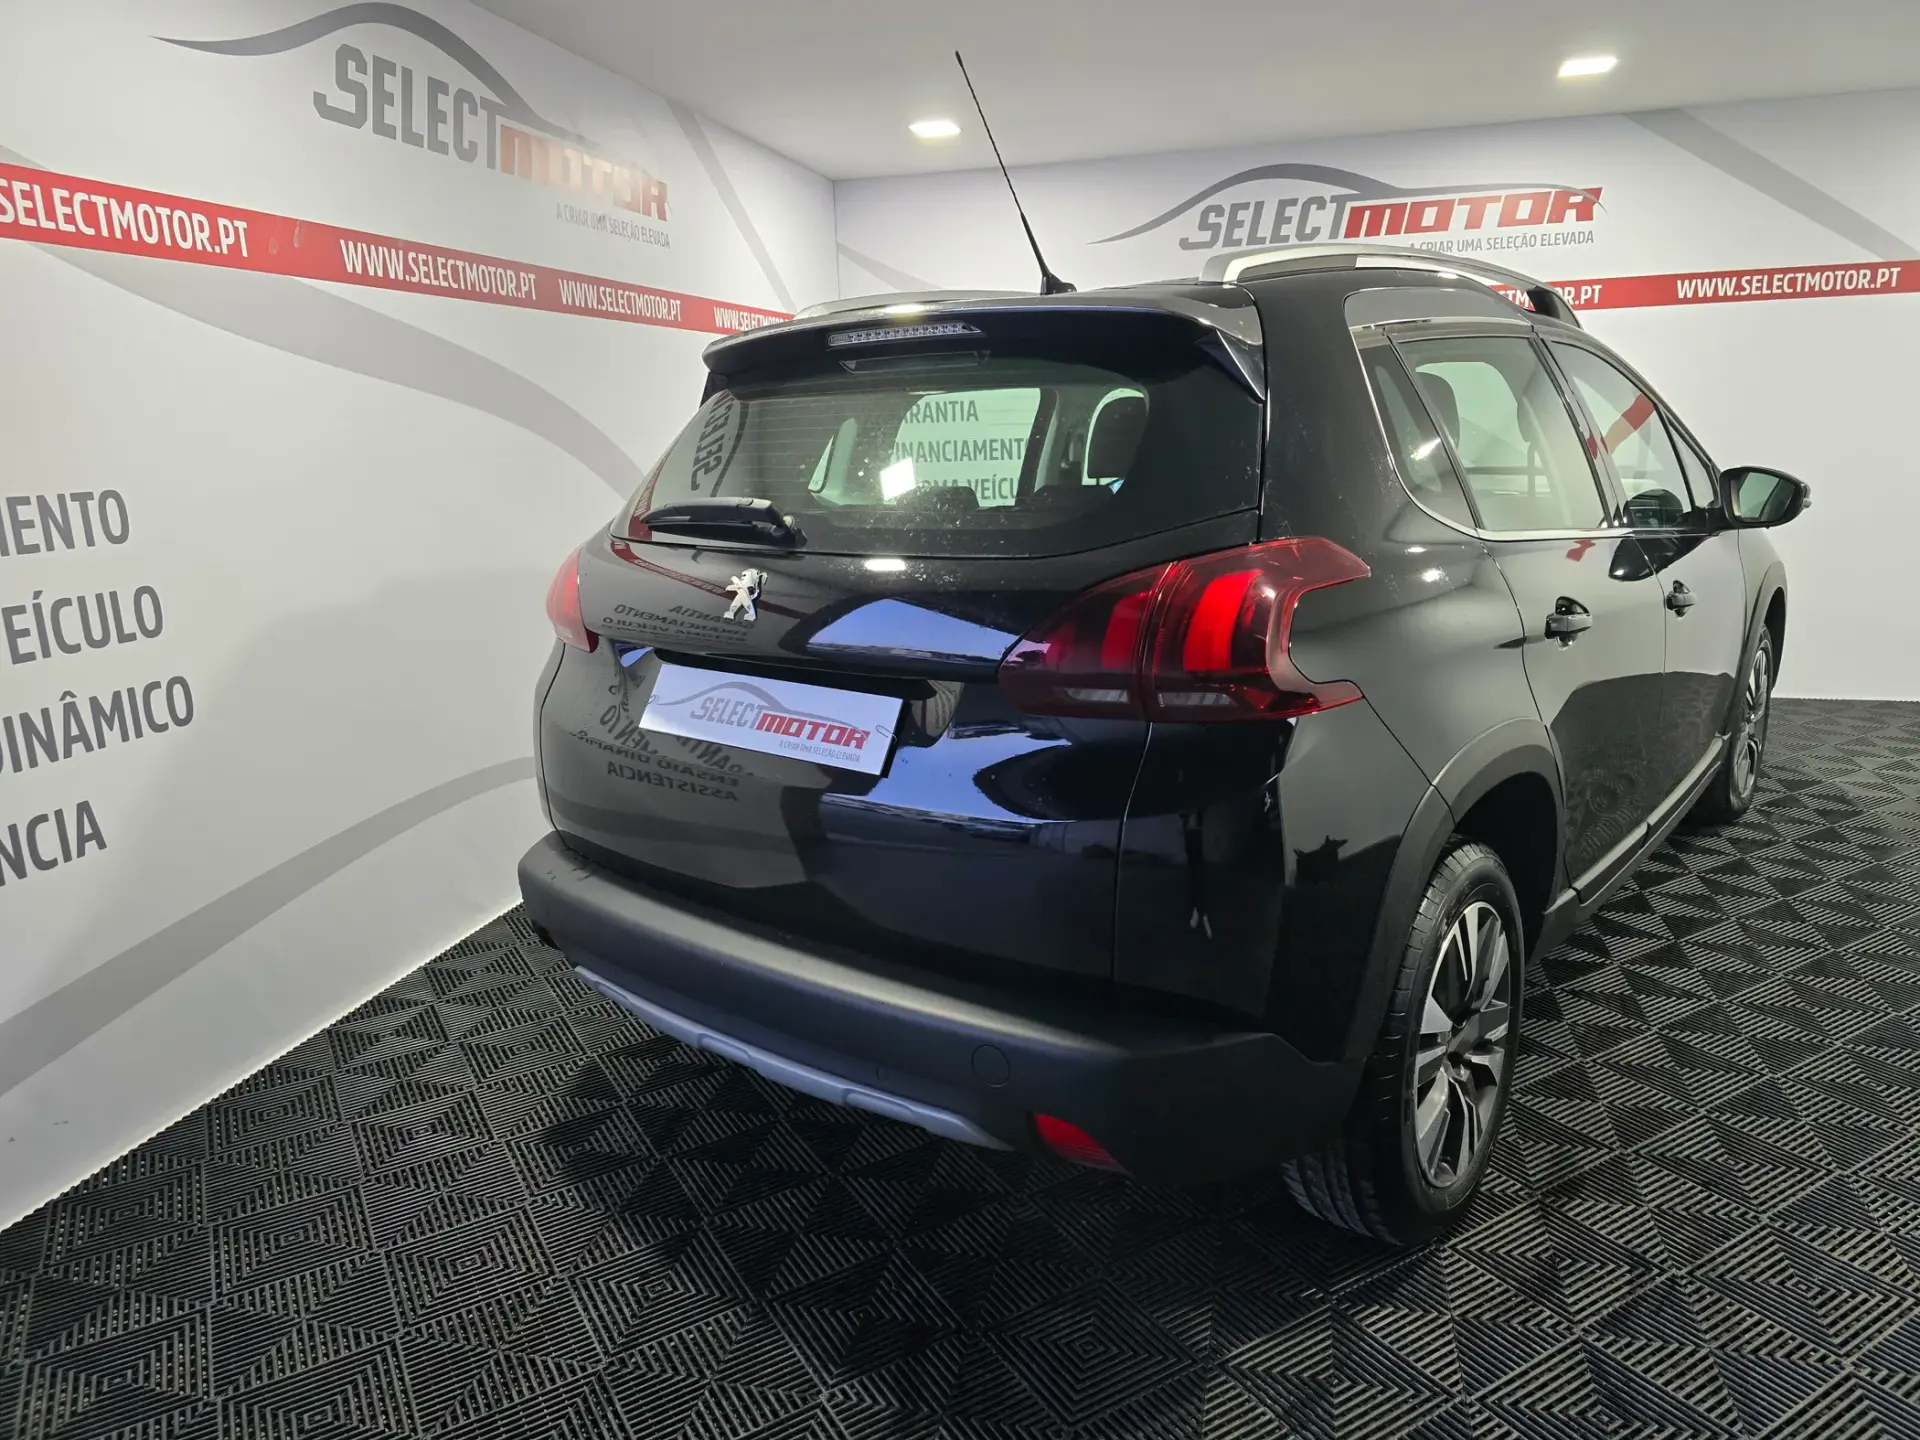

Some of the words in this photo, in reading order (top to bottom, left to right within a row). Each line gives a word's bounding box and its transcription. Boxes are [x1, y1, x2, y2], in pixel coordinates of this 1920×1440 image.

[640, 227, 671, 249] ELEVADA
[1179, 187, 1603, 251] SELECTMOTOR
[1457, 238, 1482, 252] UMA
[1486, 233, 1537, 251] SELEÇÃO
[1540, 230, 1594, 246] ELEVADA
[340, 239, 536, 300] WWW.SELECTMOTOR.PT
[1677, 267, 1901, 299] WWW.SELECTMOTOR.PT
[559, 278, 681, 322] WWW.SELECTMOTOR.PT
[904, 400, 979, 424] RANTIA
[895, 438, 1028, 463] INANCIAMENT
[0, 489, 130, 557] ENTO
[0, 676, 194, 775] INÂMICO
[690, 696, 870, 750] SELECTMOTOR
